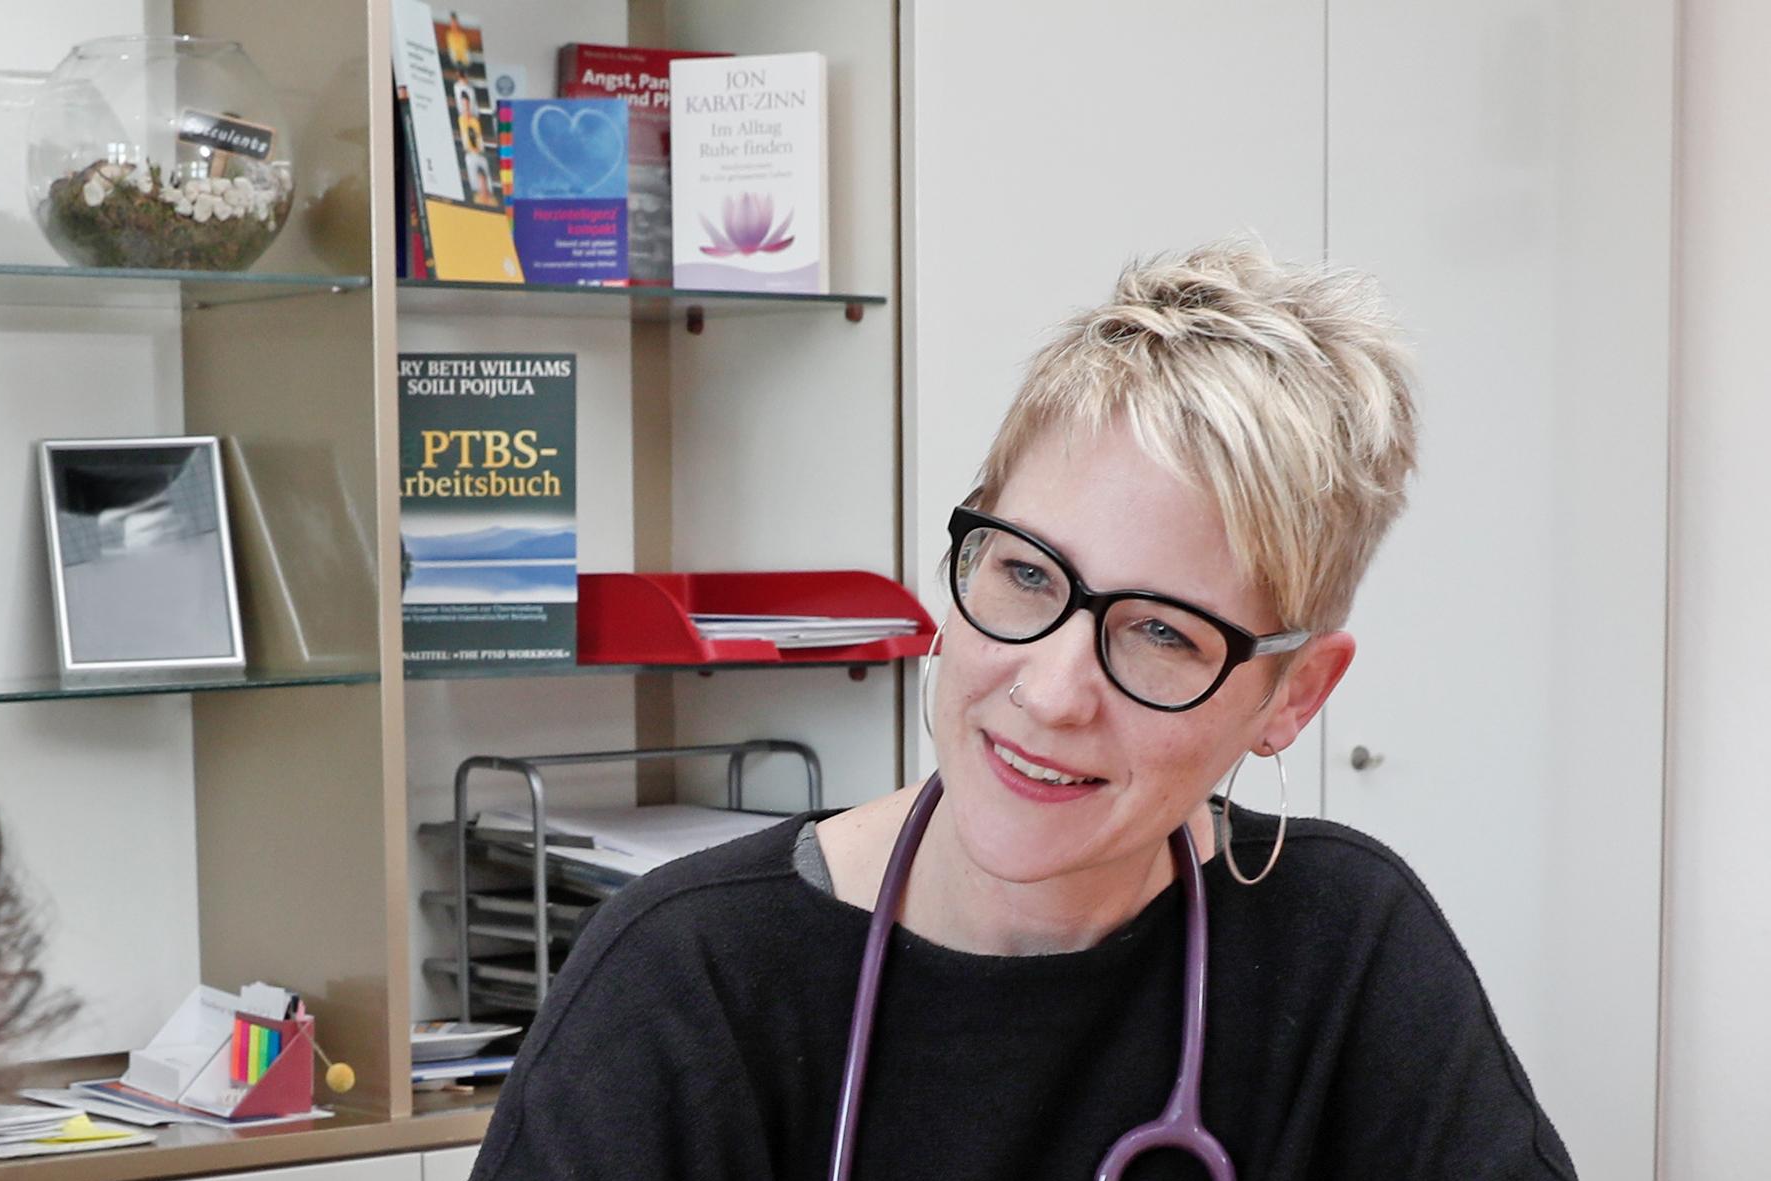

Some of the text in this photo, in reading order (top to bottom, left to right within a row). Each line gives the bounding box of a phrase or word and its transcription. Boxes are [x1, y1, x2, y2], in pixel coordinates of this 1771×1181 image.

[582, 68, 670, 92] Angst, Pan
[725, 69, 767, 91] JON
[685, 90, 806, 114] KABAT-ZINN
[711, 119, 782, 139] Im Alltag
[700, 139, 794, 158] Ruhe finden
[398, 360, 571, 378] RY BETH WILLIAMS
[407, 378, 536, 399] SOILI POIJULA
[421, 429, 559, 469] PTBS-
[399, 470, 562, 497] rbeitsbuch
